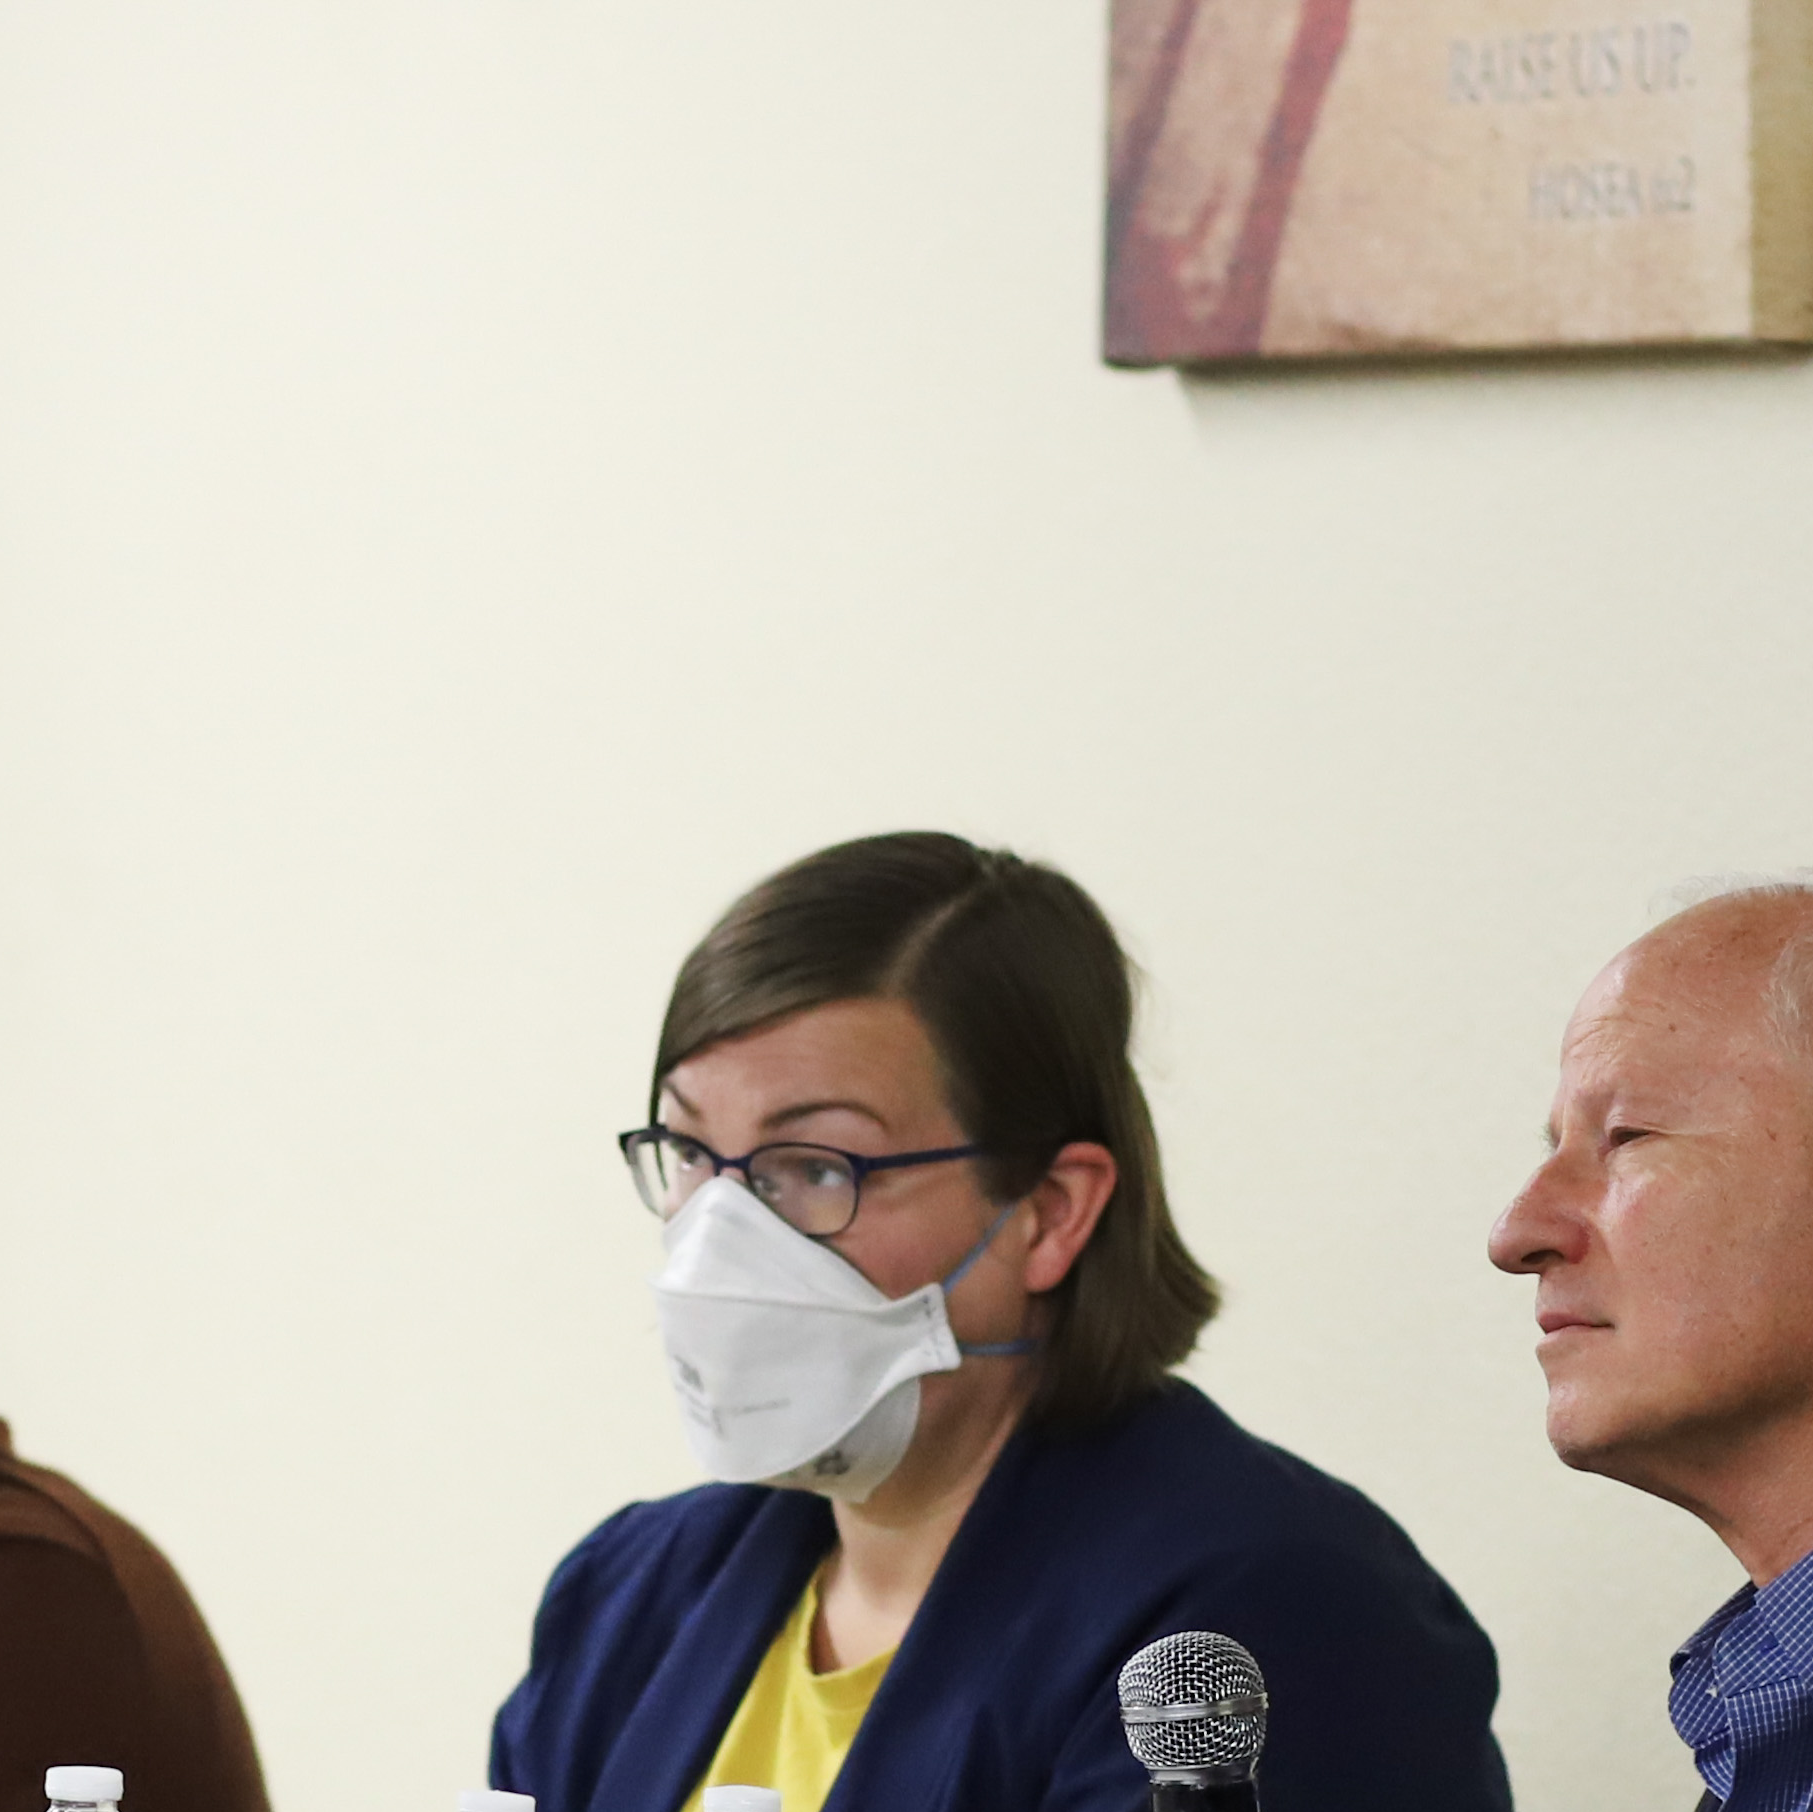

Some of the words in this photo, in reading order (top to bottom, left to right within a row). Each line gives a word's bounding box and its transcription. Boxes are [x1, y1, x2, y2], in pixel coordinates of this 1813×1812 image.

[1446, 32, 1557, 105] RAISE
[1567, 25, 1622, 98] US
[1529, 161, 1643, 219] HOSEA
